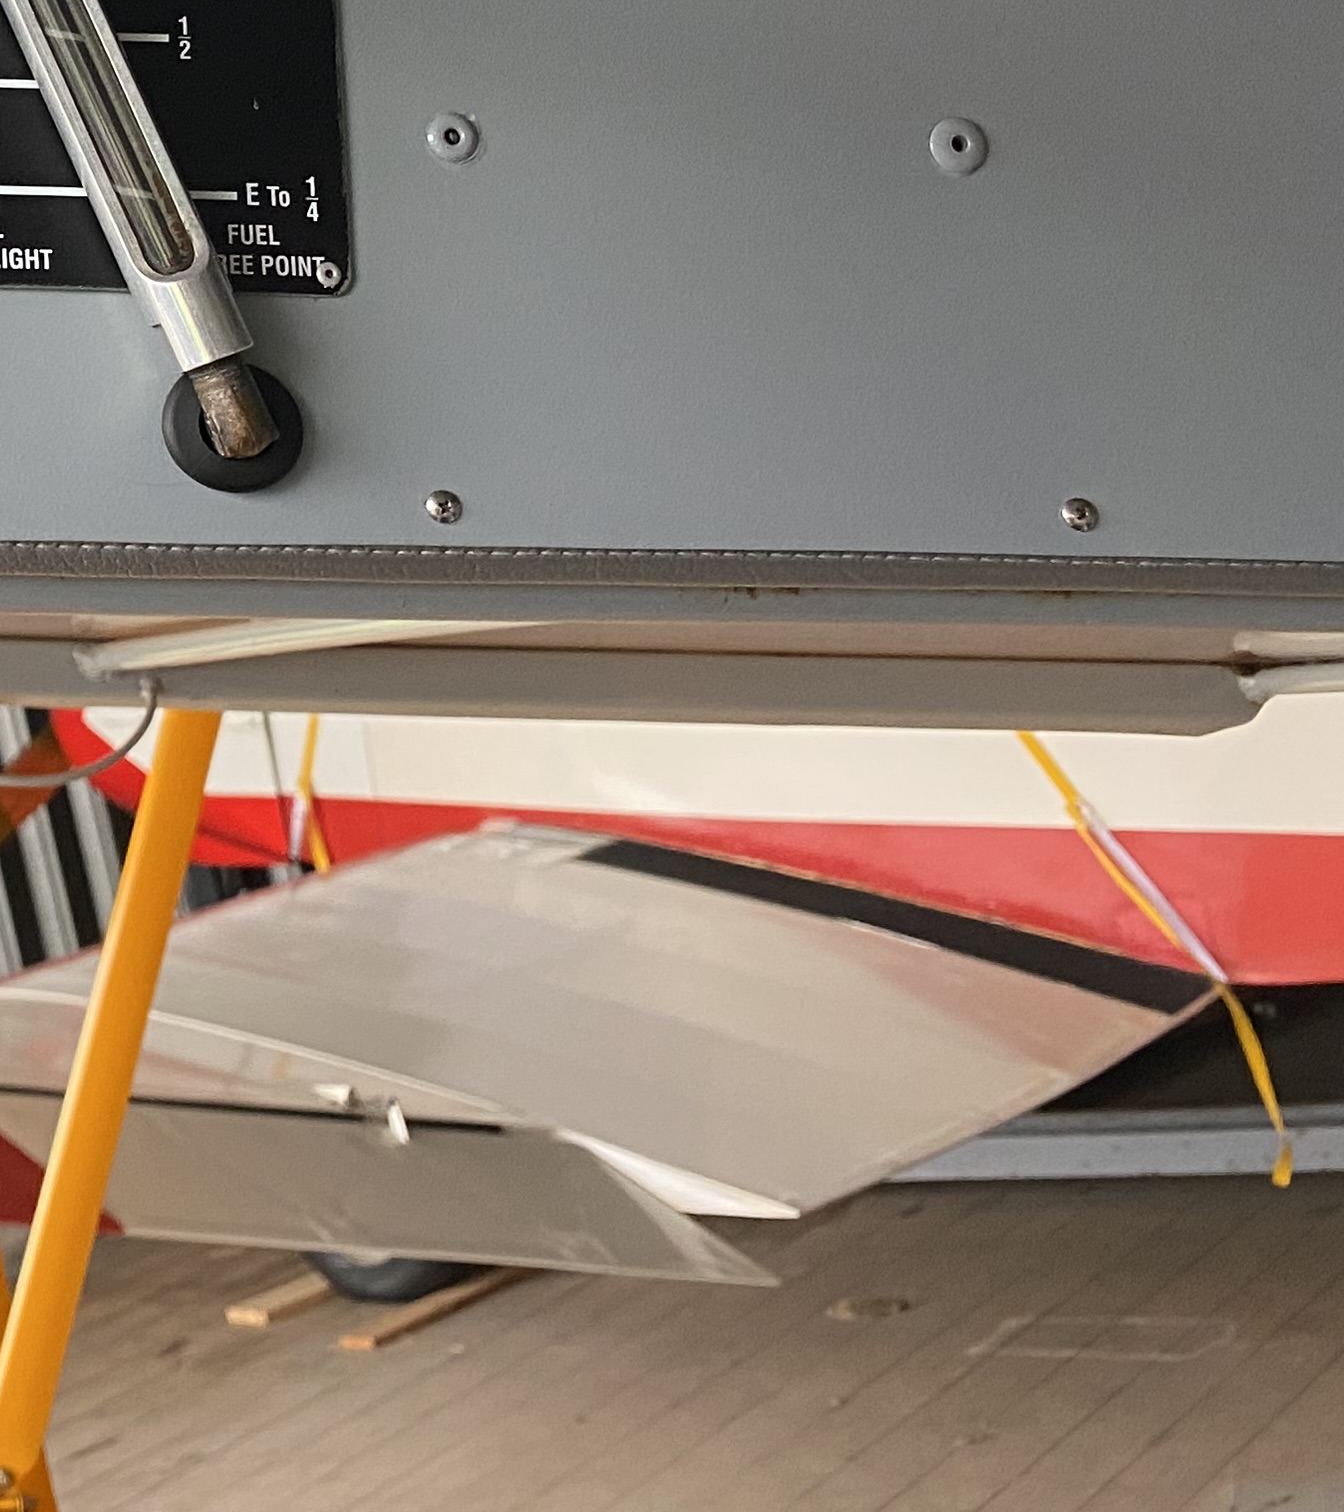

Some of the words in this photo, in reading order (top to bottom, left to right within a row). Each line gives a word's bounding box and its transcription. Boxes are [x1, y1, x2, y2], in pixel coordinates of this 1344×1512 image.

[245, 182, 260, 207] E
[267, 184, 291, 208] To
[227, 223, 281, 247] FUEL
